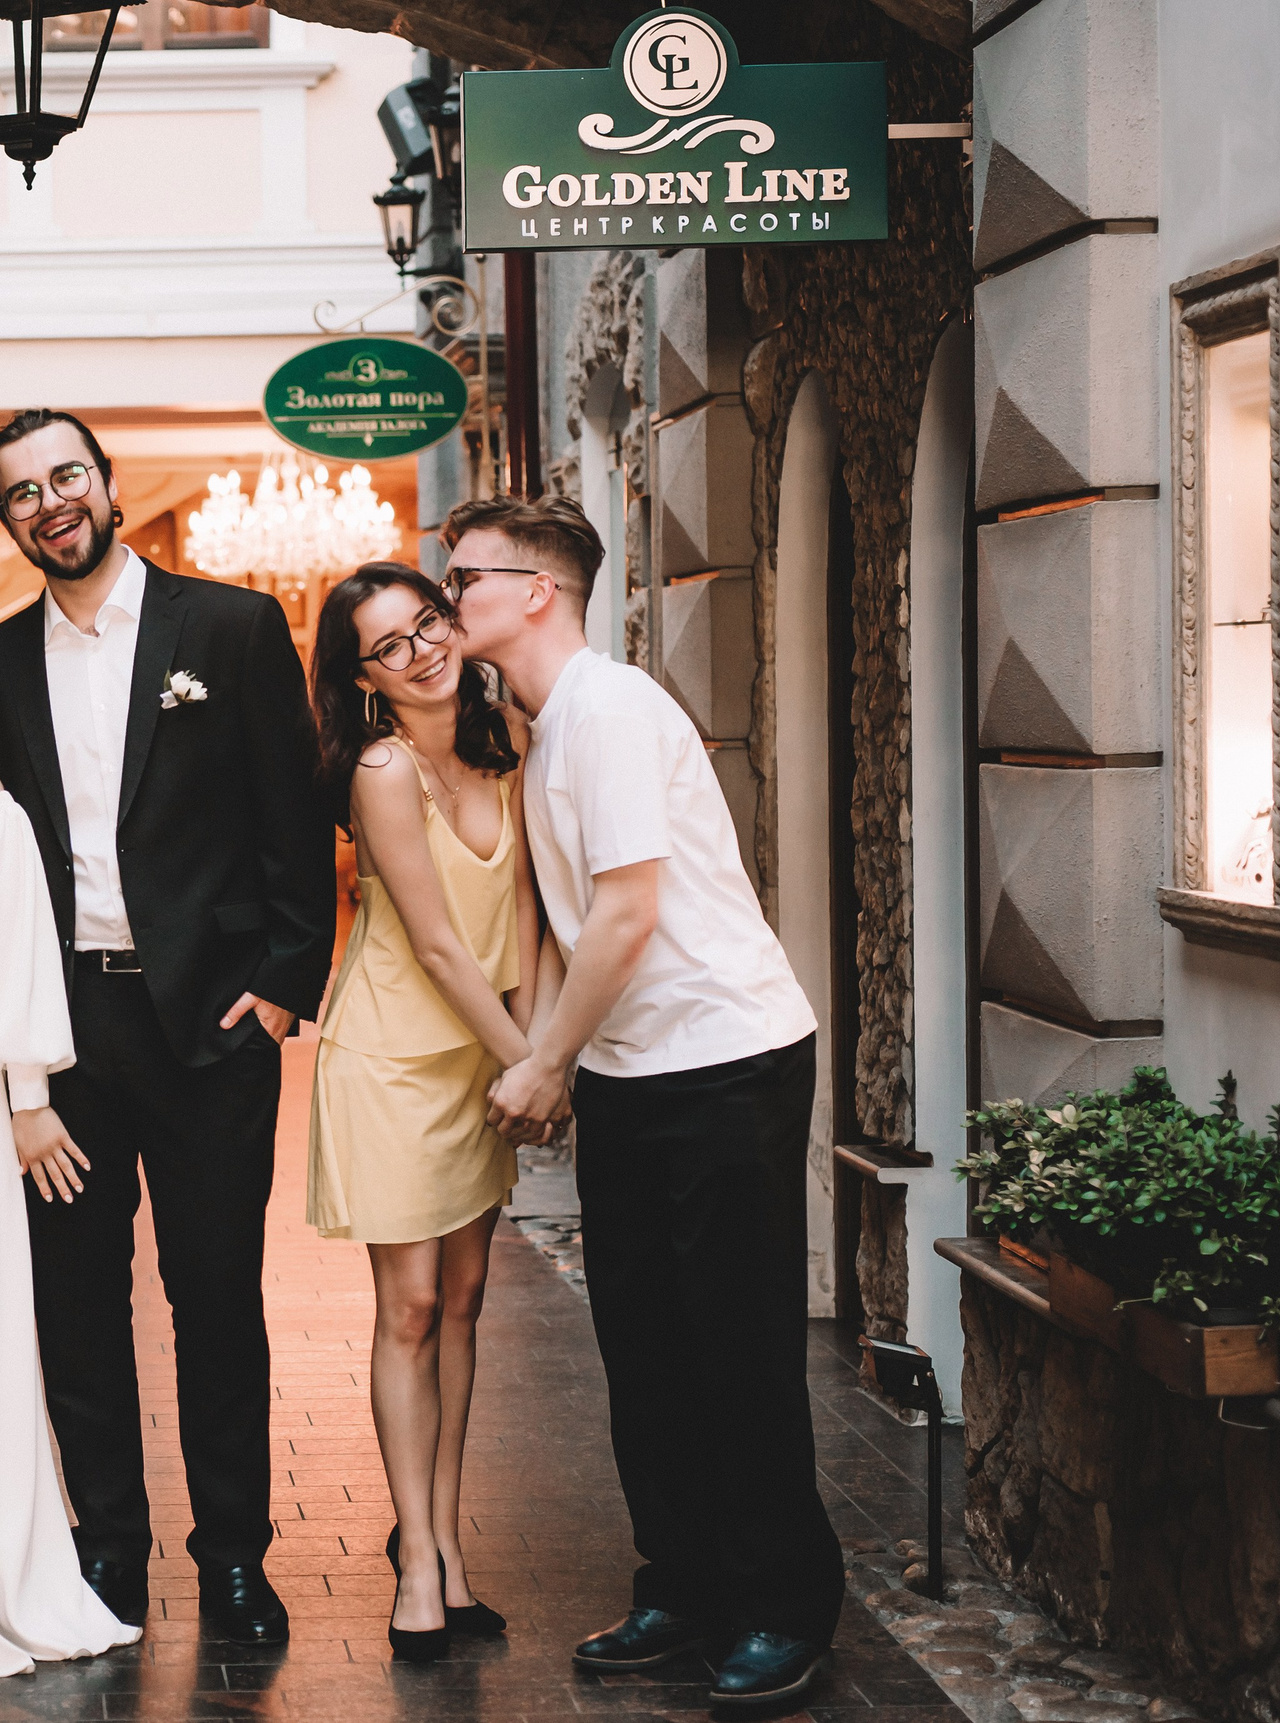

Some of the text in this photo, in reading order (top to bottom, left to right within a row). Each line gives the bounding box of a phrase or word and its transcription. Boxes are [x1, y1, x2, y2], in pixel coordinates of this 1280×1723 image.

[648, 35, 698, 91] GL
[502, 161, 851, 209] GOLDEN LINE
[521, 212, 831, 239] ЦЕНТР КРАСОТЫ
[284, 386, 445, 412] Золотая пора
